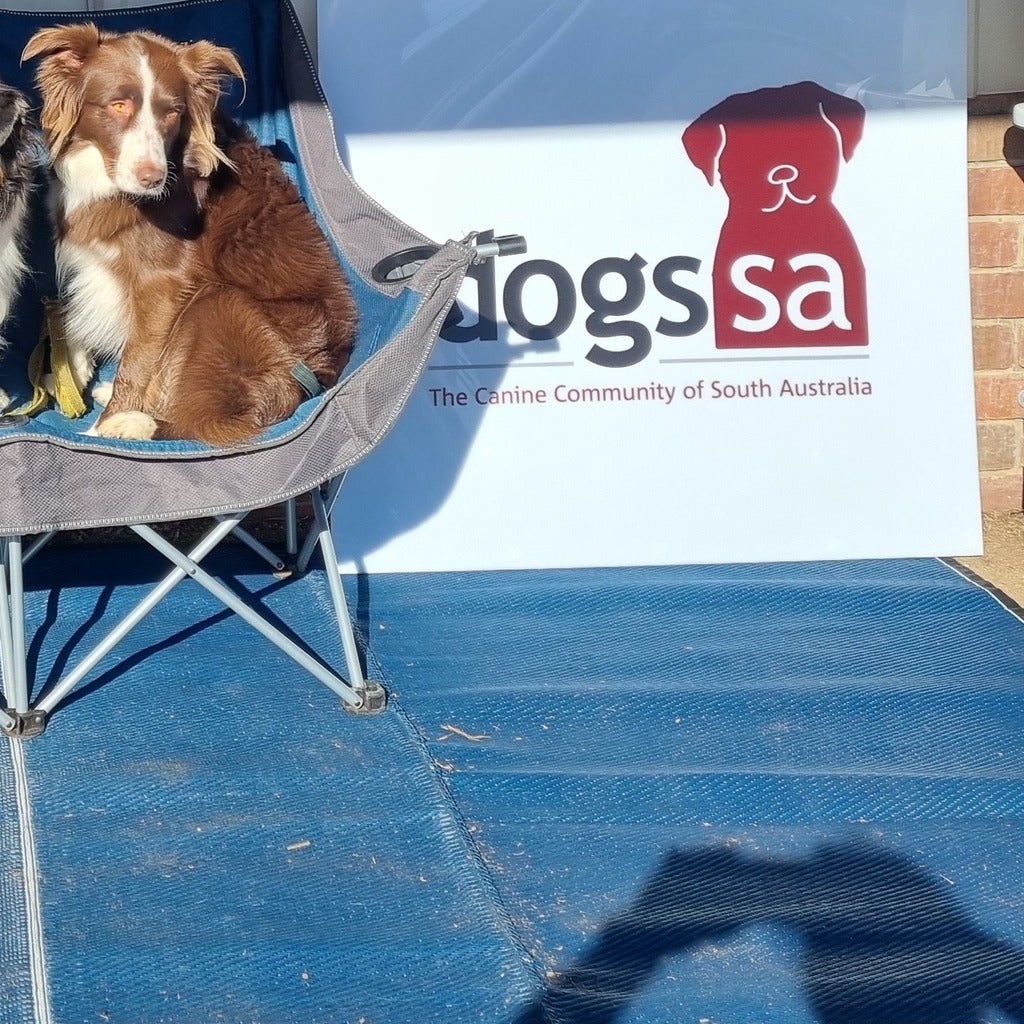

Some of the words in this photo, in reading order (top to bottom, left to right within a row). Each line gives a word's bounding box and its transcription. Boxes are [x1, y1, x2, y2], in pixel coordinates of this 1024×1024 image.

[439, 229, 709, 368] dogs
[730, 252, 853, 333] sa
[429, 386, 469, 408] The
[475, 384, 547, 406] Canine
[554, 381, 676, 407] Community
[683, 380, 705, 400] of
[711, 379, 772, 400] South
[779, 376, 873, 398] Australia
